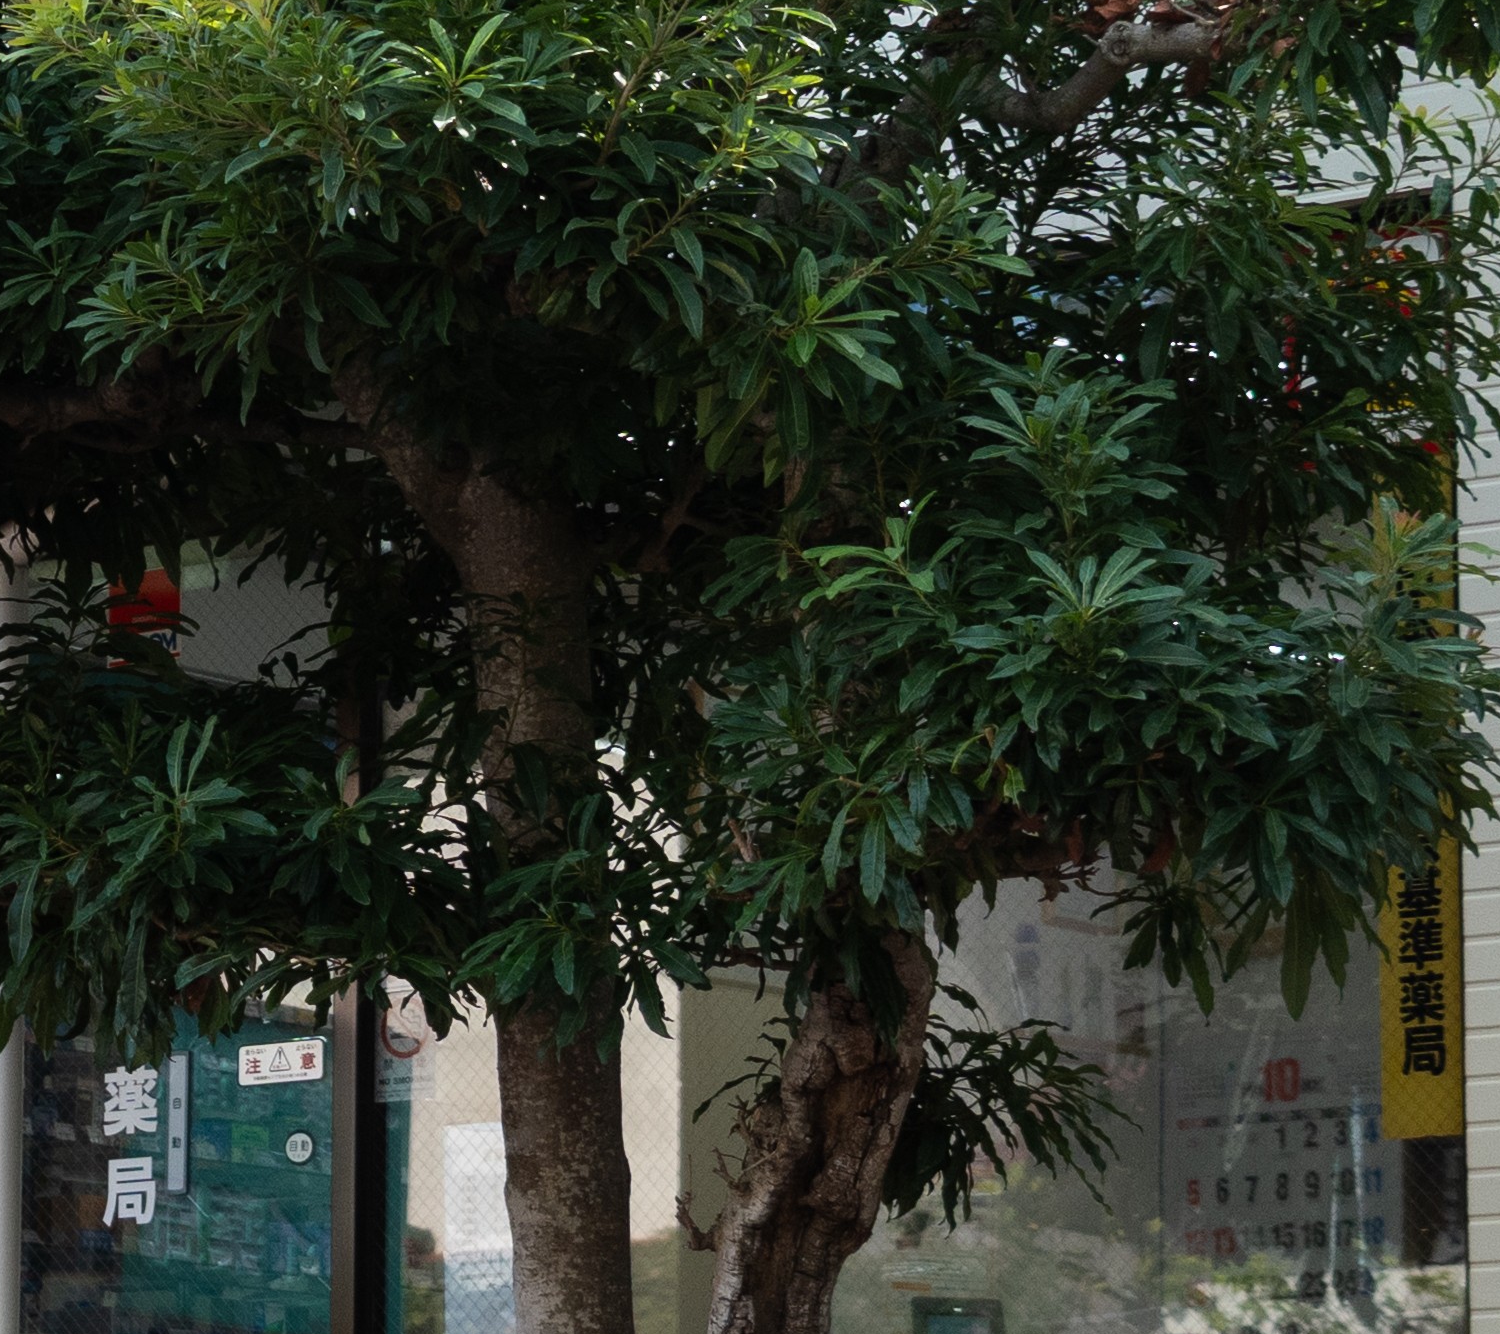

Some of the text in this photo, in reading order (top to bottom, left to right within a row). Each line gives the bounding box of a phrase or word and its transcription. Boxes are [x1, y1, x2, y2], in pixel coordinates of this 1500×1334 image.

[1397, 833, 1447, 1077] 基準薬局
[1264, 1057, 1300, 1103] 10
[103, 1065, 158, 1227] 薬局
[289, 1140, 310, 1152] 自動
[1303, 1121, 1318, 1148] 2
[1334, 1120, 1347, 1146] 3
[1187, 1179, 1200, 1206] 5
[1216, 1177, 1229, 1204] 6
[1245, 1175, 1259, 1202] 7
[1276, 1172, 1288, 1201] 8
[1304, 1170, 1320, 1199] 9
